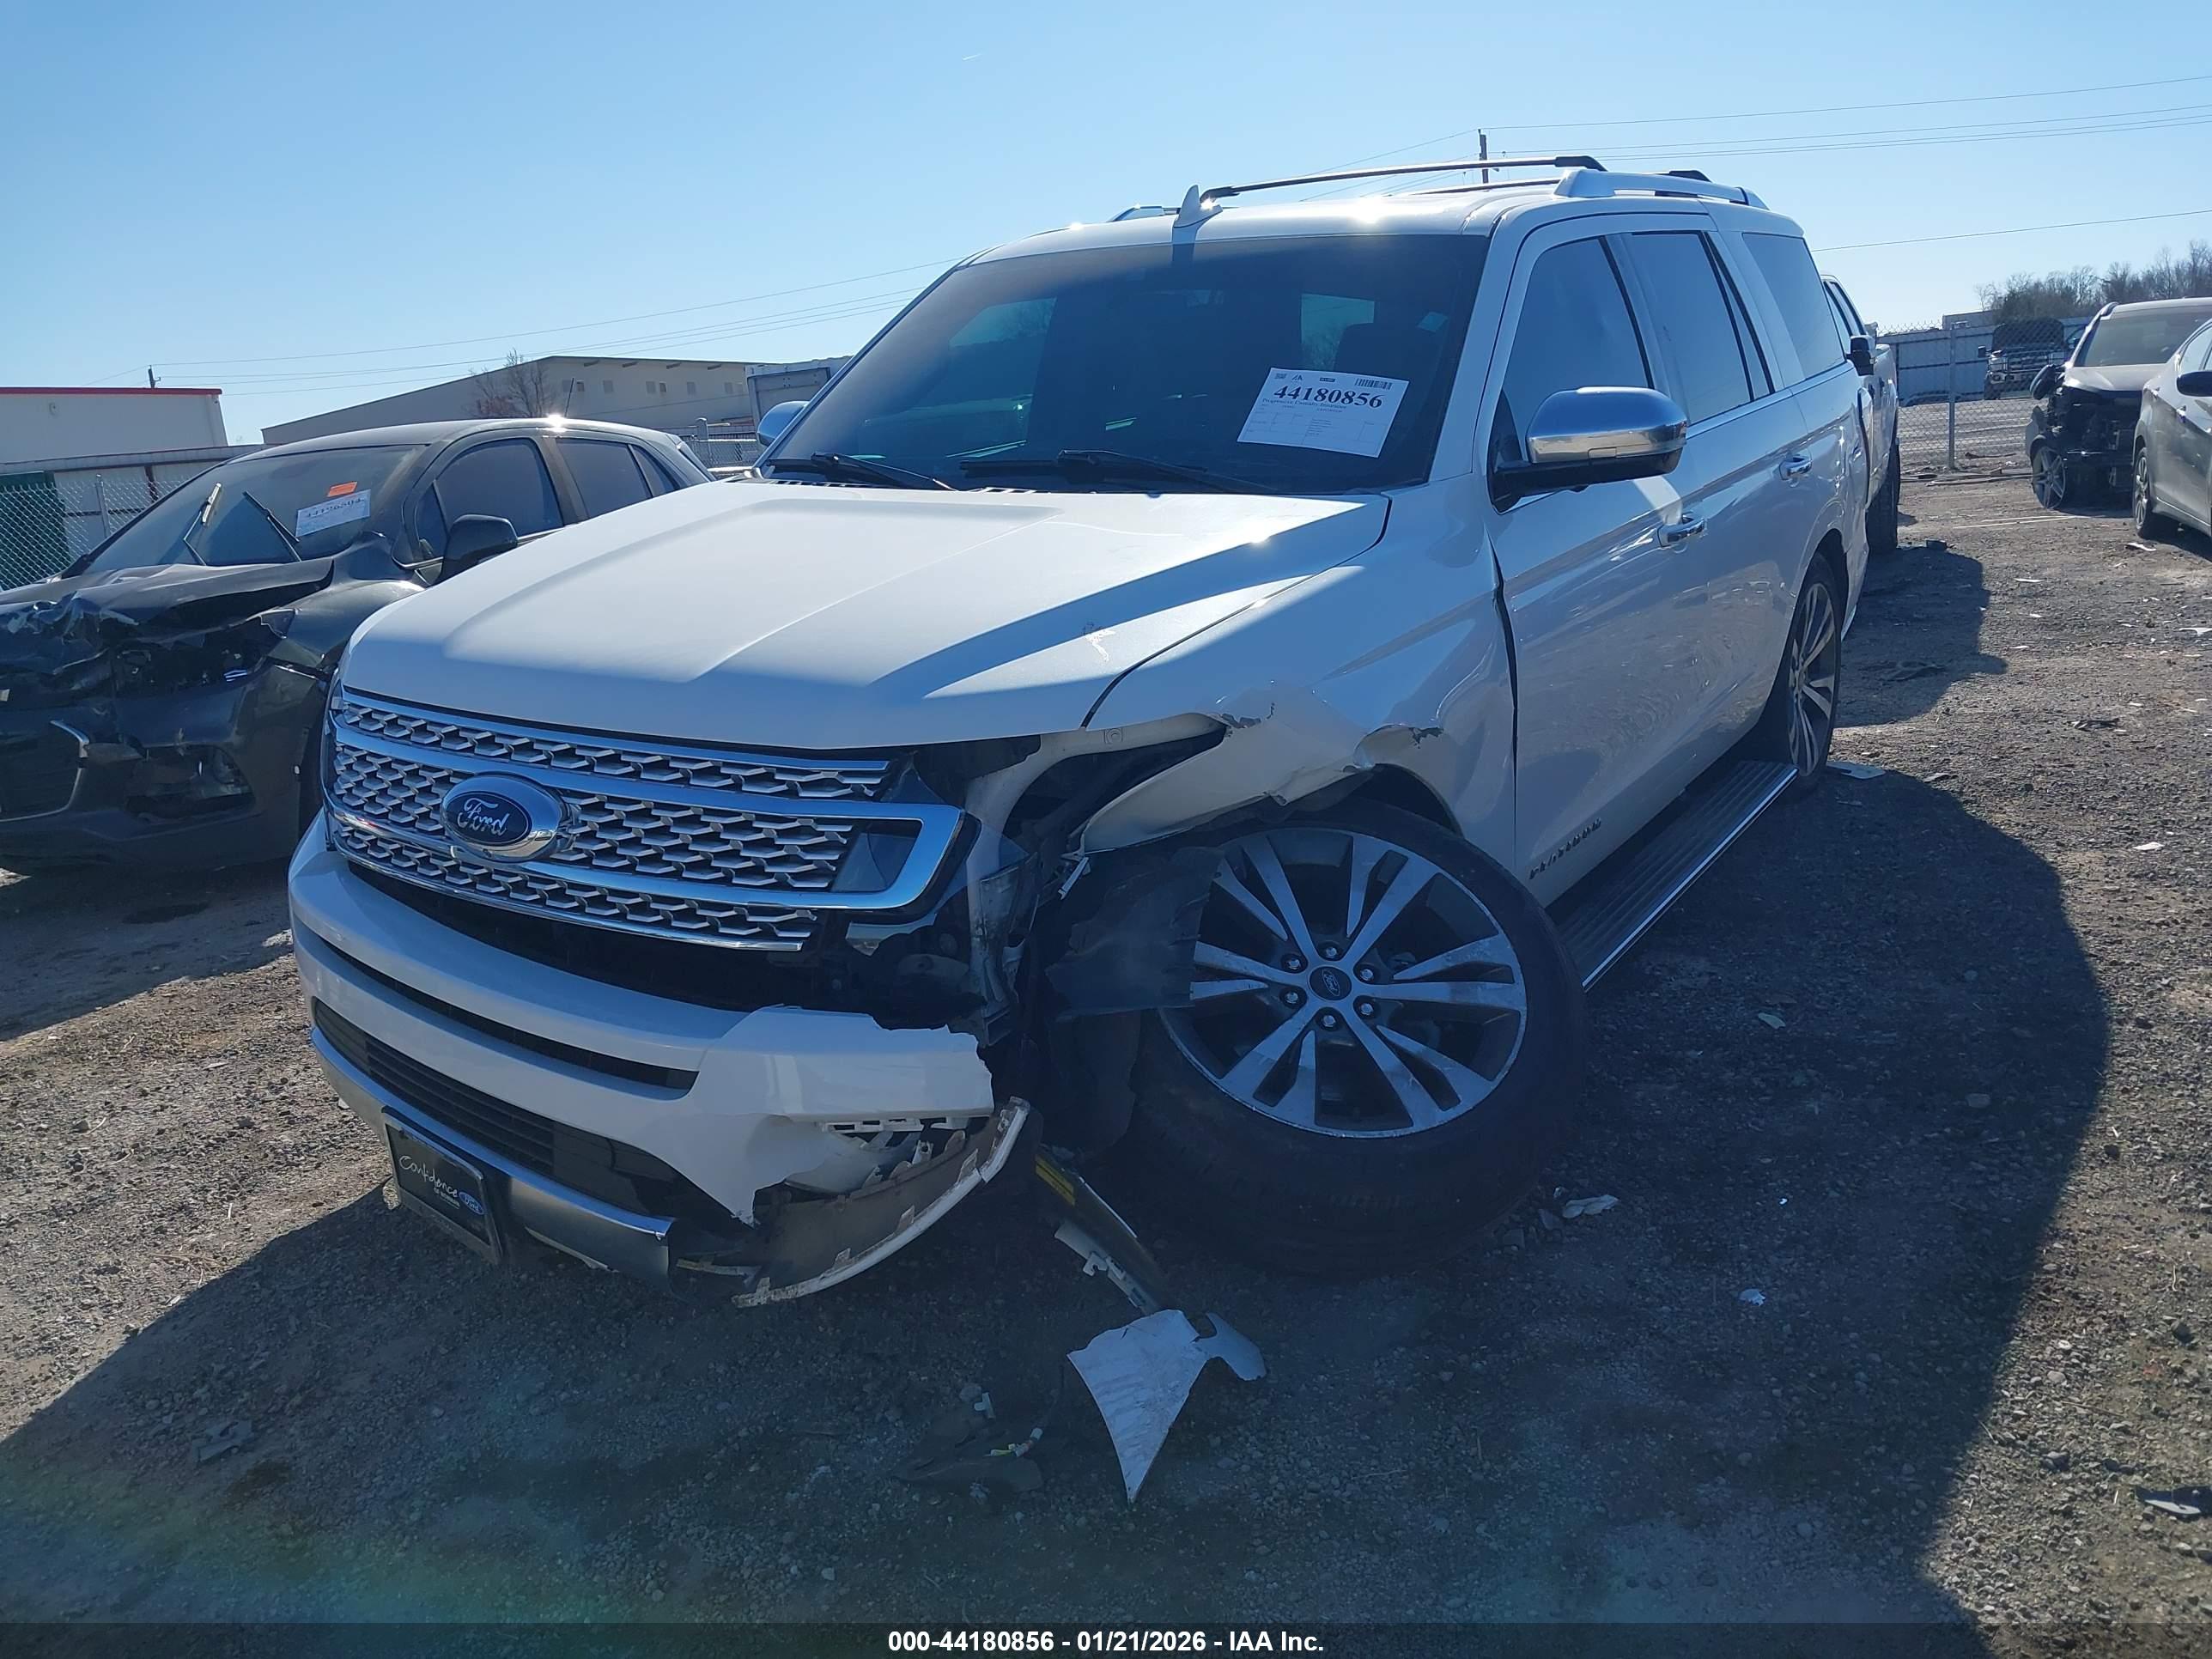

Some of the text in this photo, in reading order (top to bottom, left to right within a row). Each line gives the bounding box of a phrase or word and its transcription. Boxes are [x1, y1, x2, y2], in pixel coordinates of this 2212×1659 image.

[1273, 385, 1386, 409] 44180856
[457, 797, 510, 836] Ford
[398, 1155, 459, 1198] Confidence
